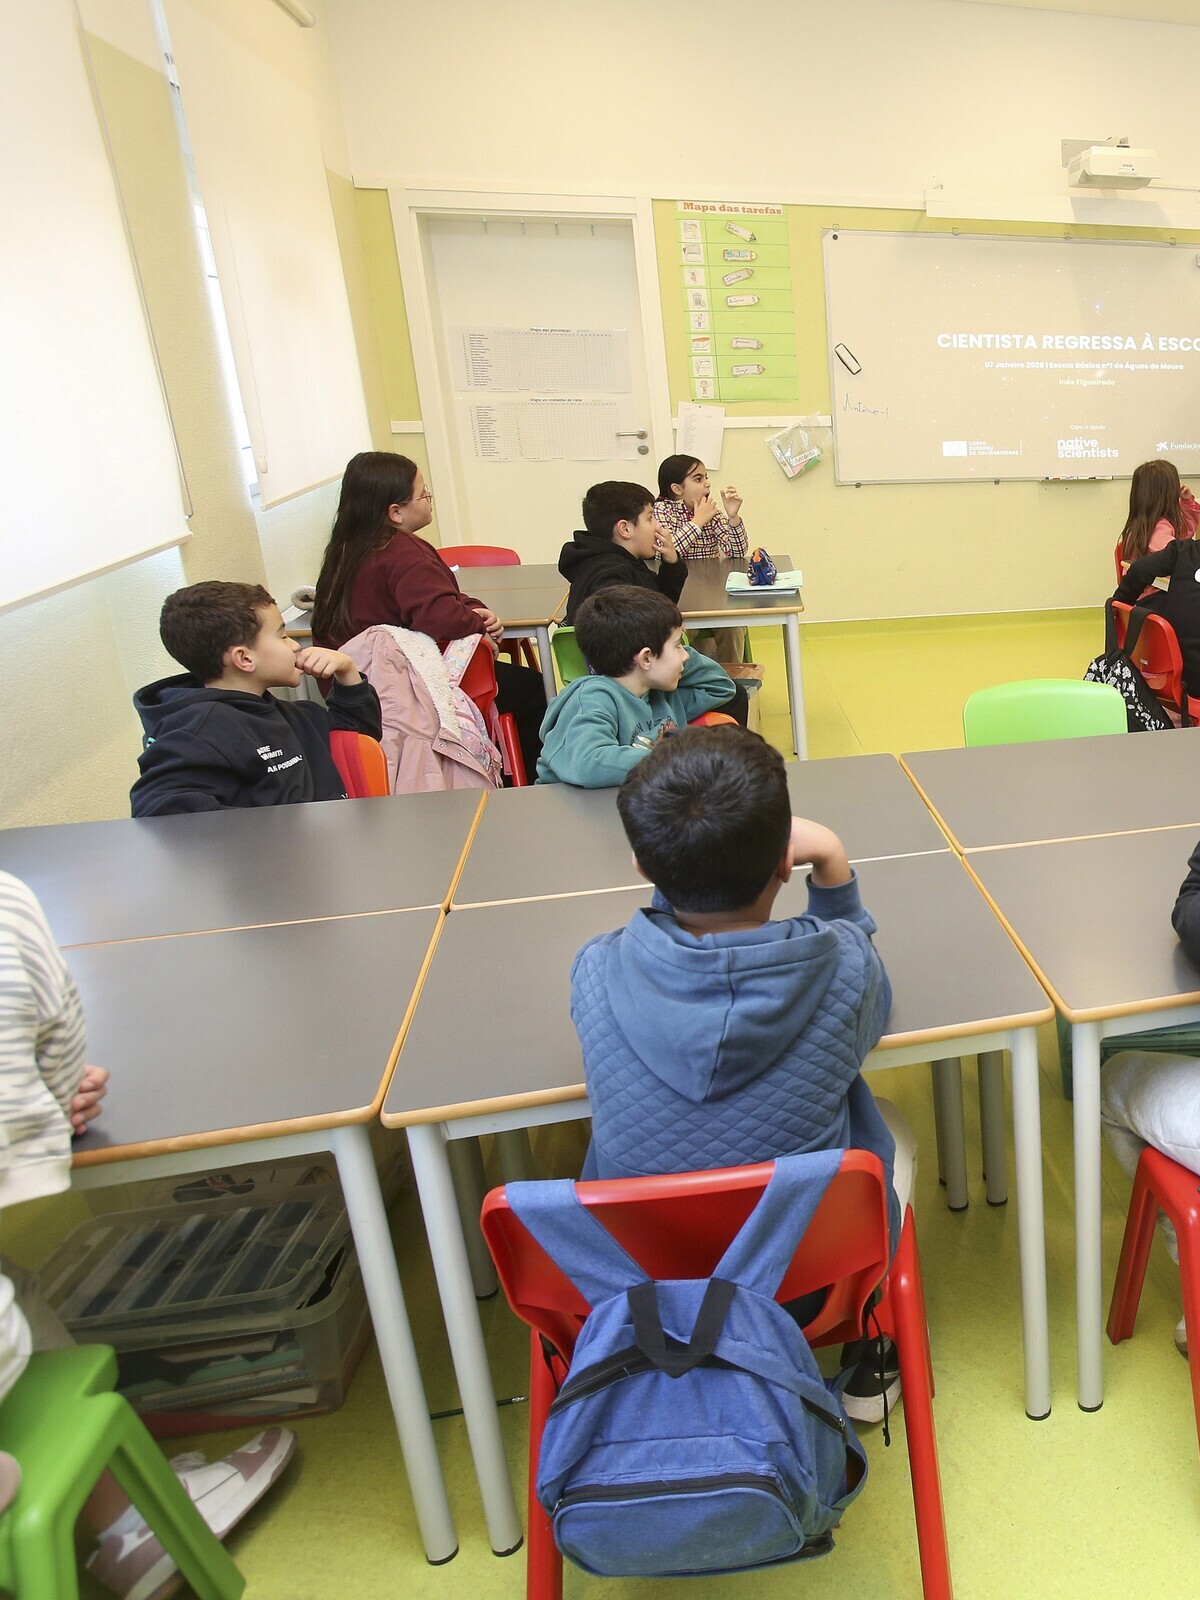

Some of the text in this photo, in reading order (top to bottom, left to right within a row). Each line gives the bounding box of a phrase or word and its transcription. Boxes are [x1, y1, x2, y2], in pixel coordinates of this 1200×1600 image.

[684, 202, 716, 212] Mapa
[936, 333, 1037, 350] CIENTISTA
[1042, 334, 1138, 351] REGRESSA
[1140, 332, 1155, 351] À
[1125, 361, 1148, 371] Águas
[1058, 437, 1098, 448] native
[1058, 447, 1119, 458] scientists
